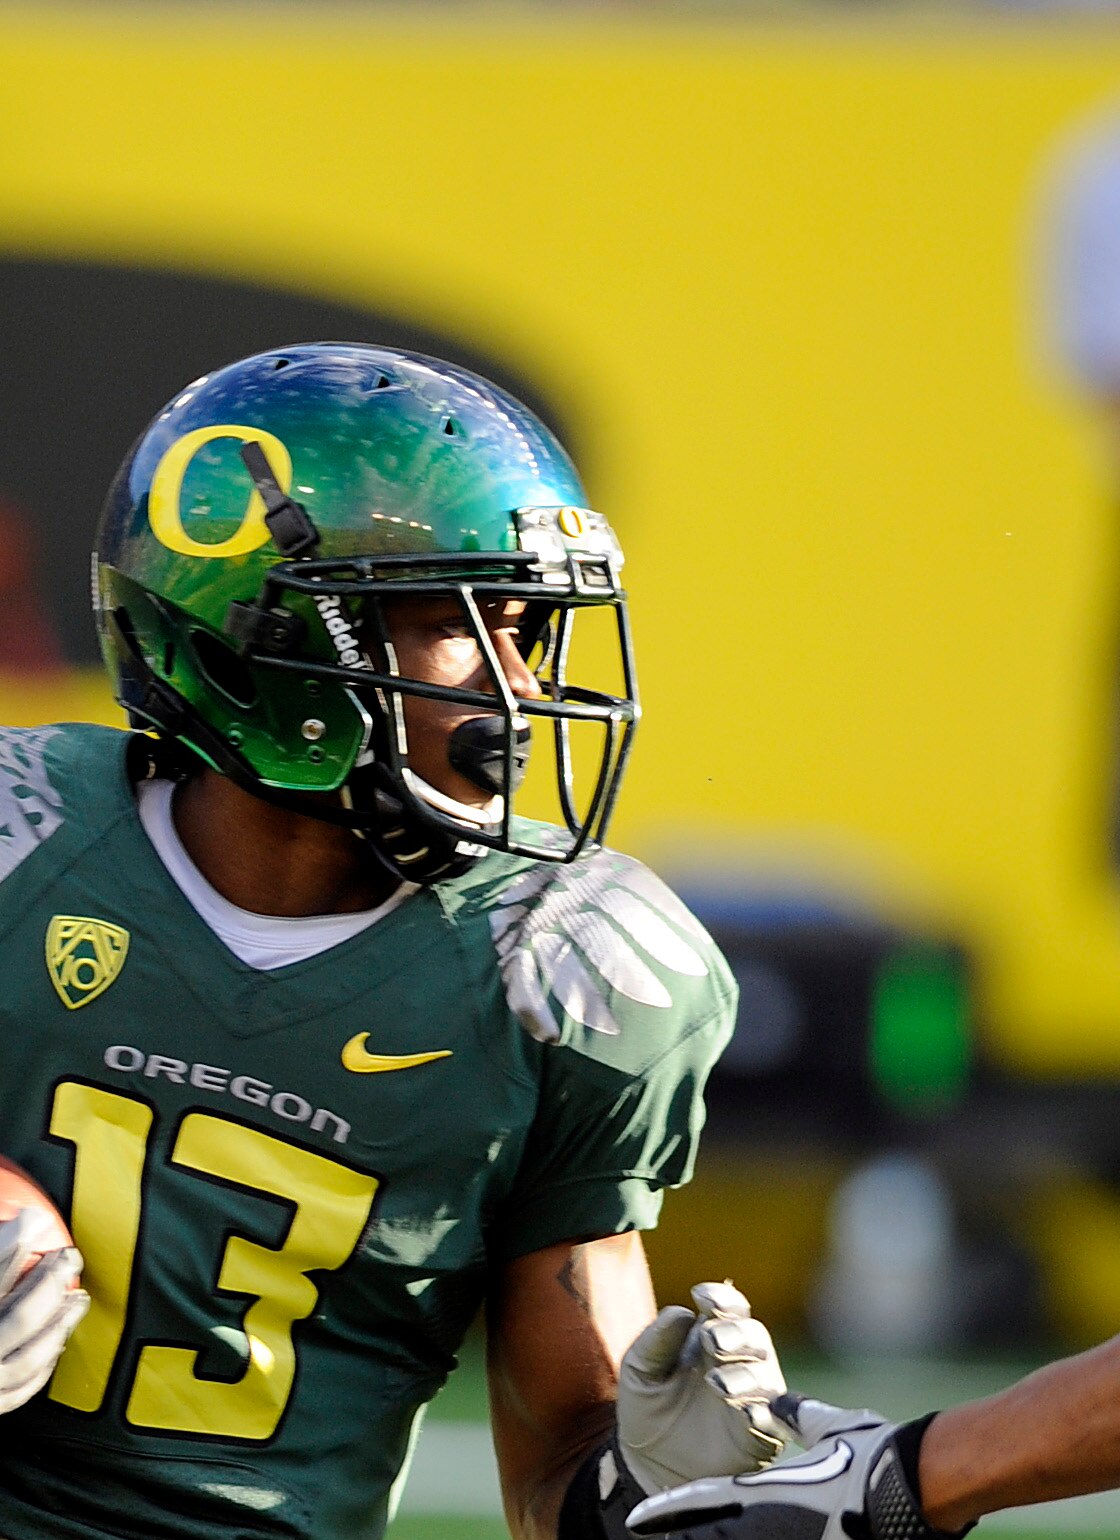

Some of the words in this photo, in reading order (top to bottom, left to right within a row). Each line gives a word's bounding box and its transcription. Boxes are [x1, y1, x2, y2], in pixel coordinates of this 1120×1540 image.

[52, 919, 126, 978] PAC
[103, 1045, 352, 1144] OREGON
[47, 1080, 380, 1441] 13
